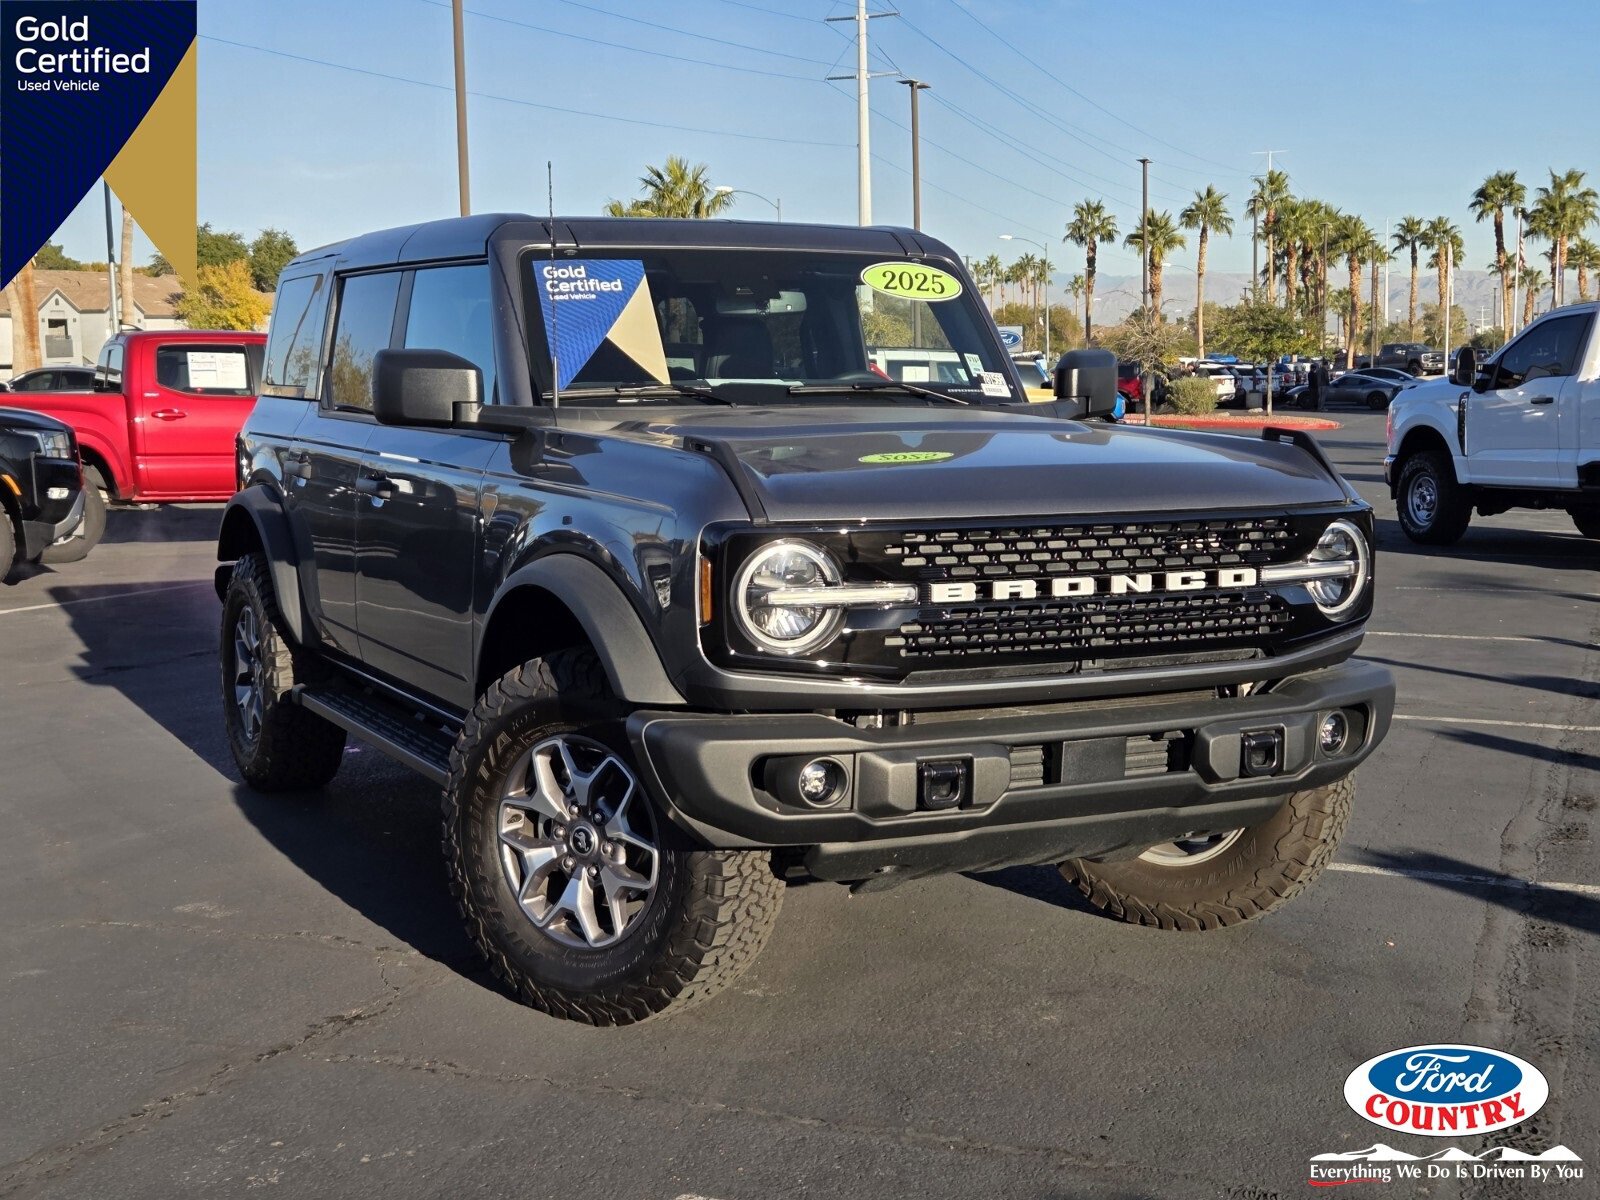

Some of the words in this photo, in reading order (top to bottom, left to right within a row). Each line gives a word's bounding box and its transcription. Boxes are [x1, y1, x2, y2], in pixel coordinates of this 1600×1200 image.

[543, 265, 586, 279] Gold
[546, 278, 623, 292] Certified
[882, 270, 945, 294] 2025
[930, 568, 1257, 603] BRONCO
